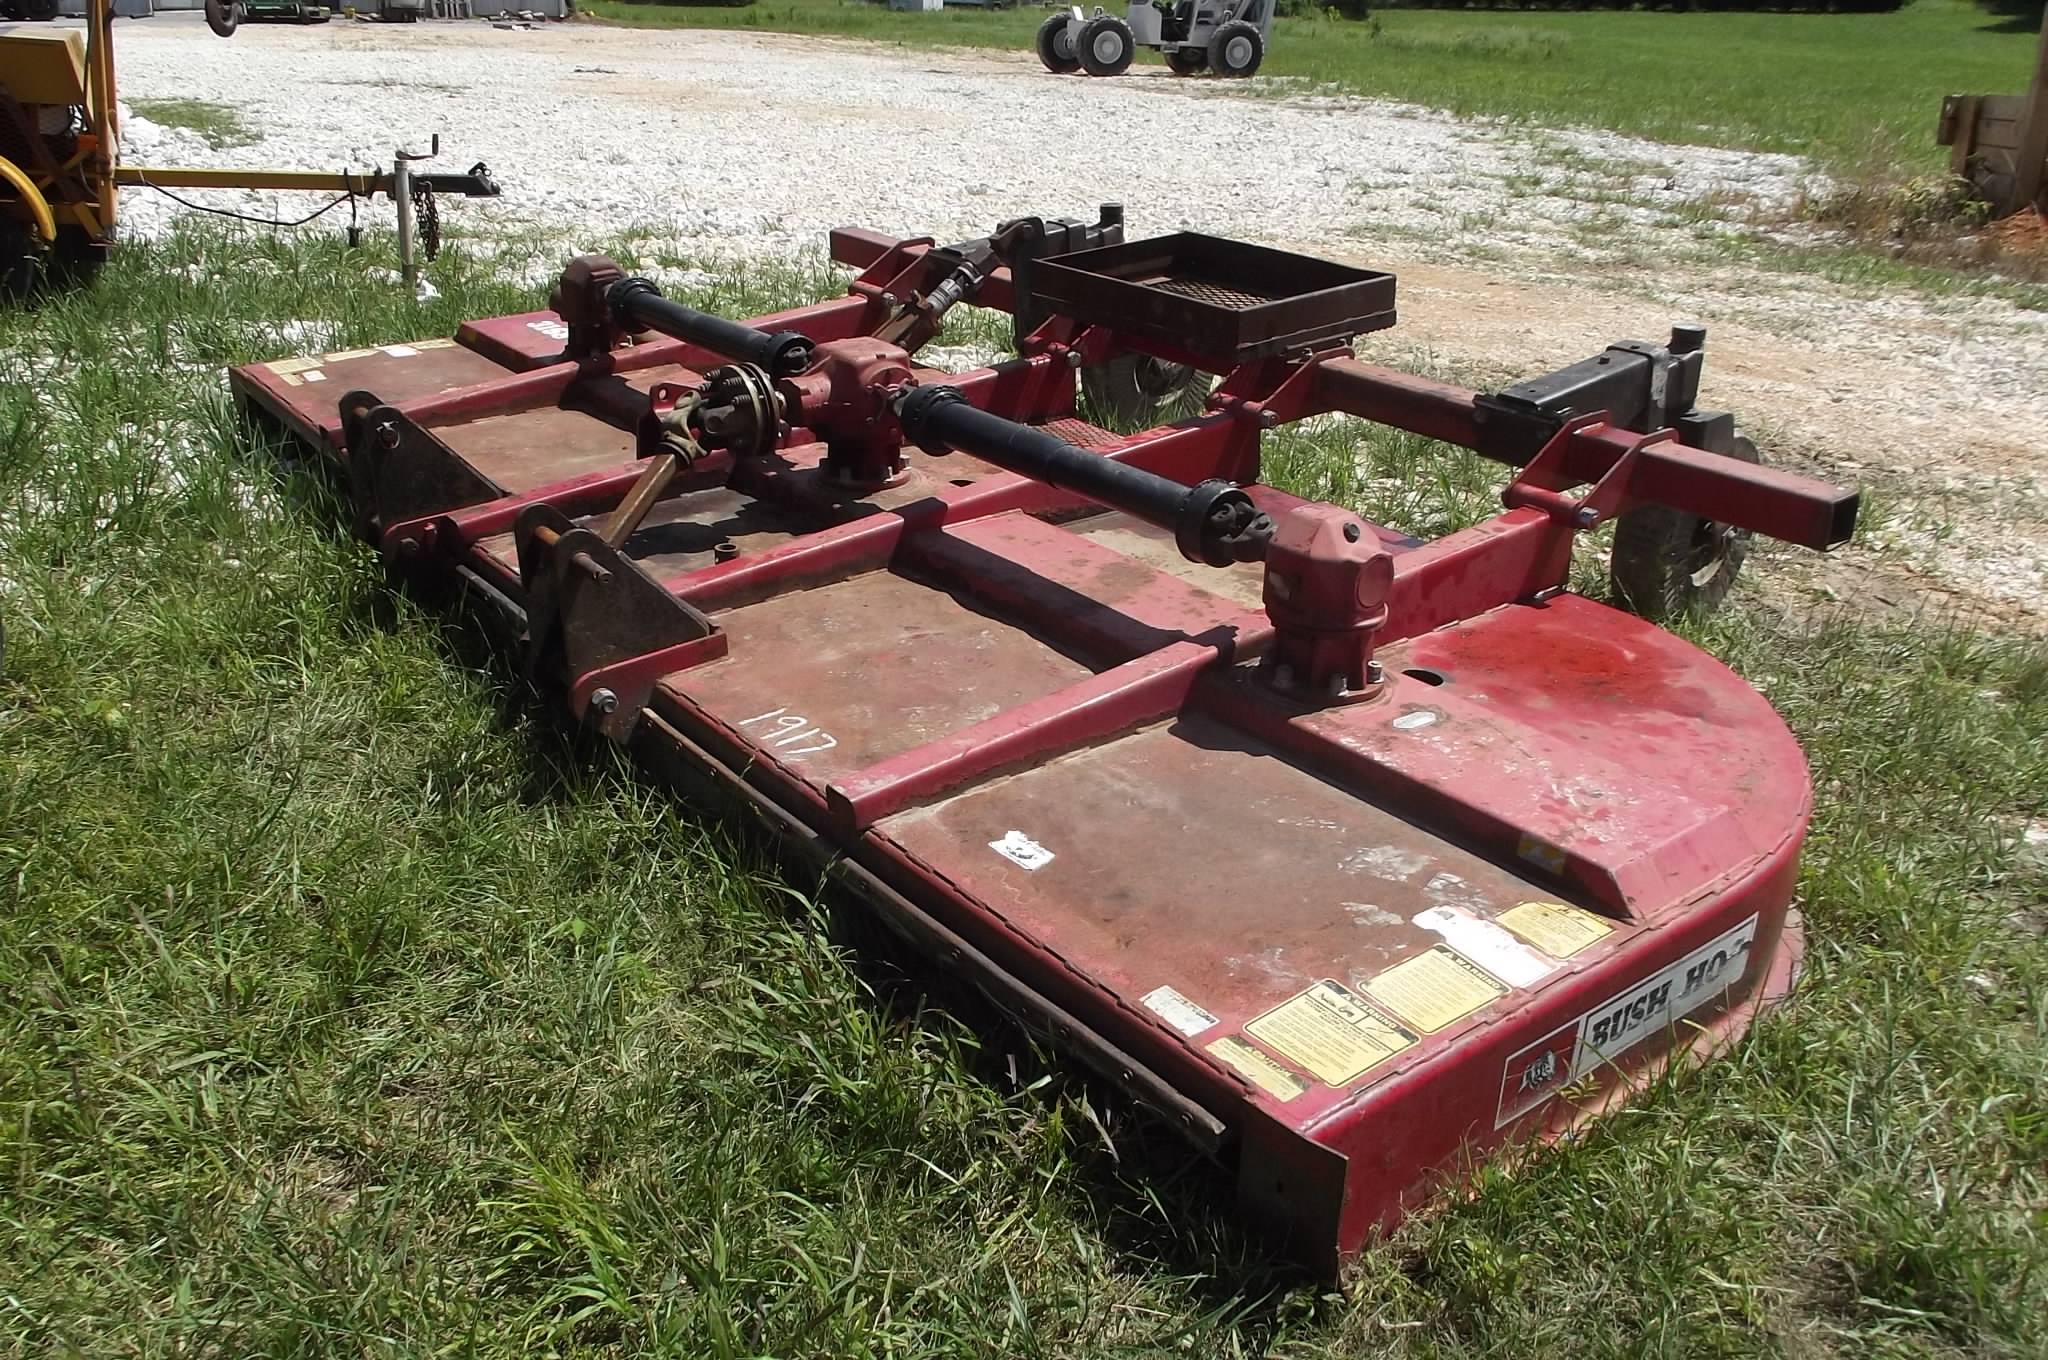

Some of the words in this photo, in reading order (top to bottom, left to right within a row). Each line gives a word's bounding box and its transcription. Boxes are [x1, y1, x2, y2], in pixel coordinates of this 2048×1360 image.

[739, 707, 838, 754] 1917
[1455, 958, 1501, 989] WARNING
[1353, 998, 1398, 1029] WARNING
[1592, 979, 1674, 1049] BUSH
